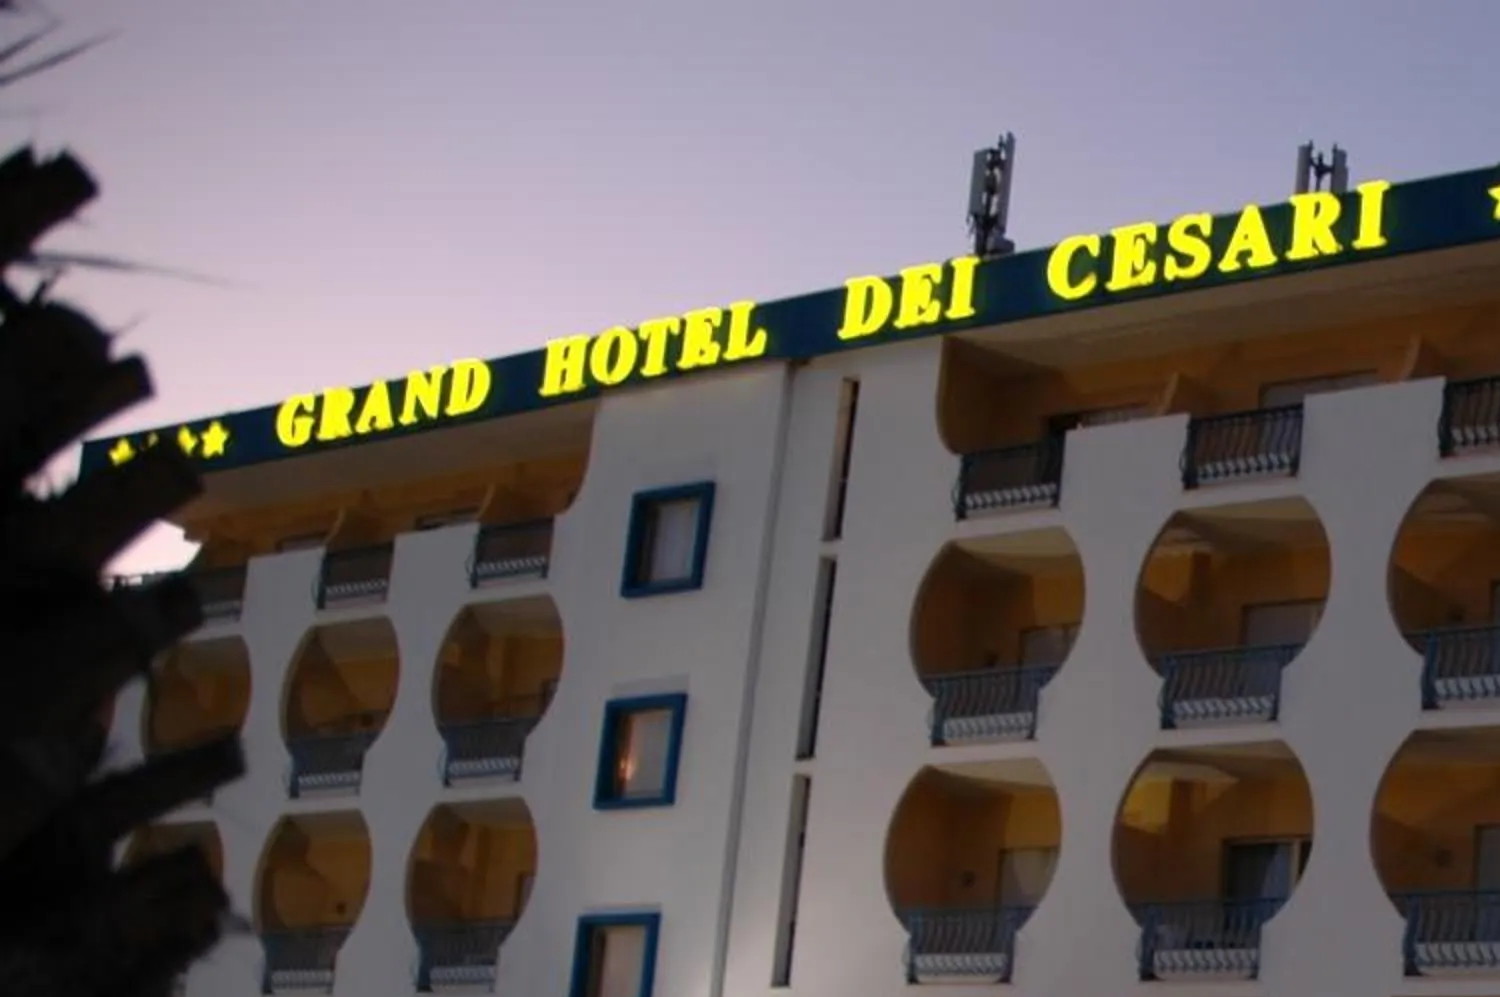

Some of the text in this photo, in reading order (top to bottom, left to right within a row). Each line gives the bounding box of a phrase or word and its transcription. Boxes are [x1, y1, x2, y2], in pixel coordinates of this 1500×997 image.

[276, 180, 1390, 447] GRAND HOTEL DEI CESARI
